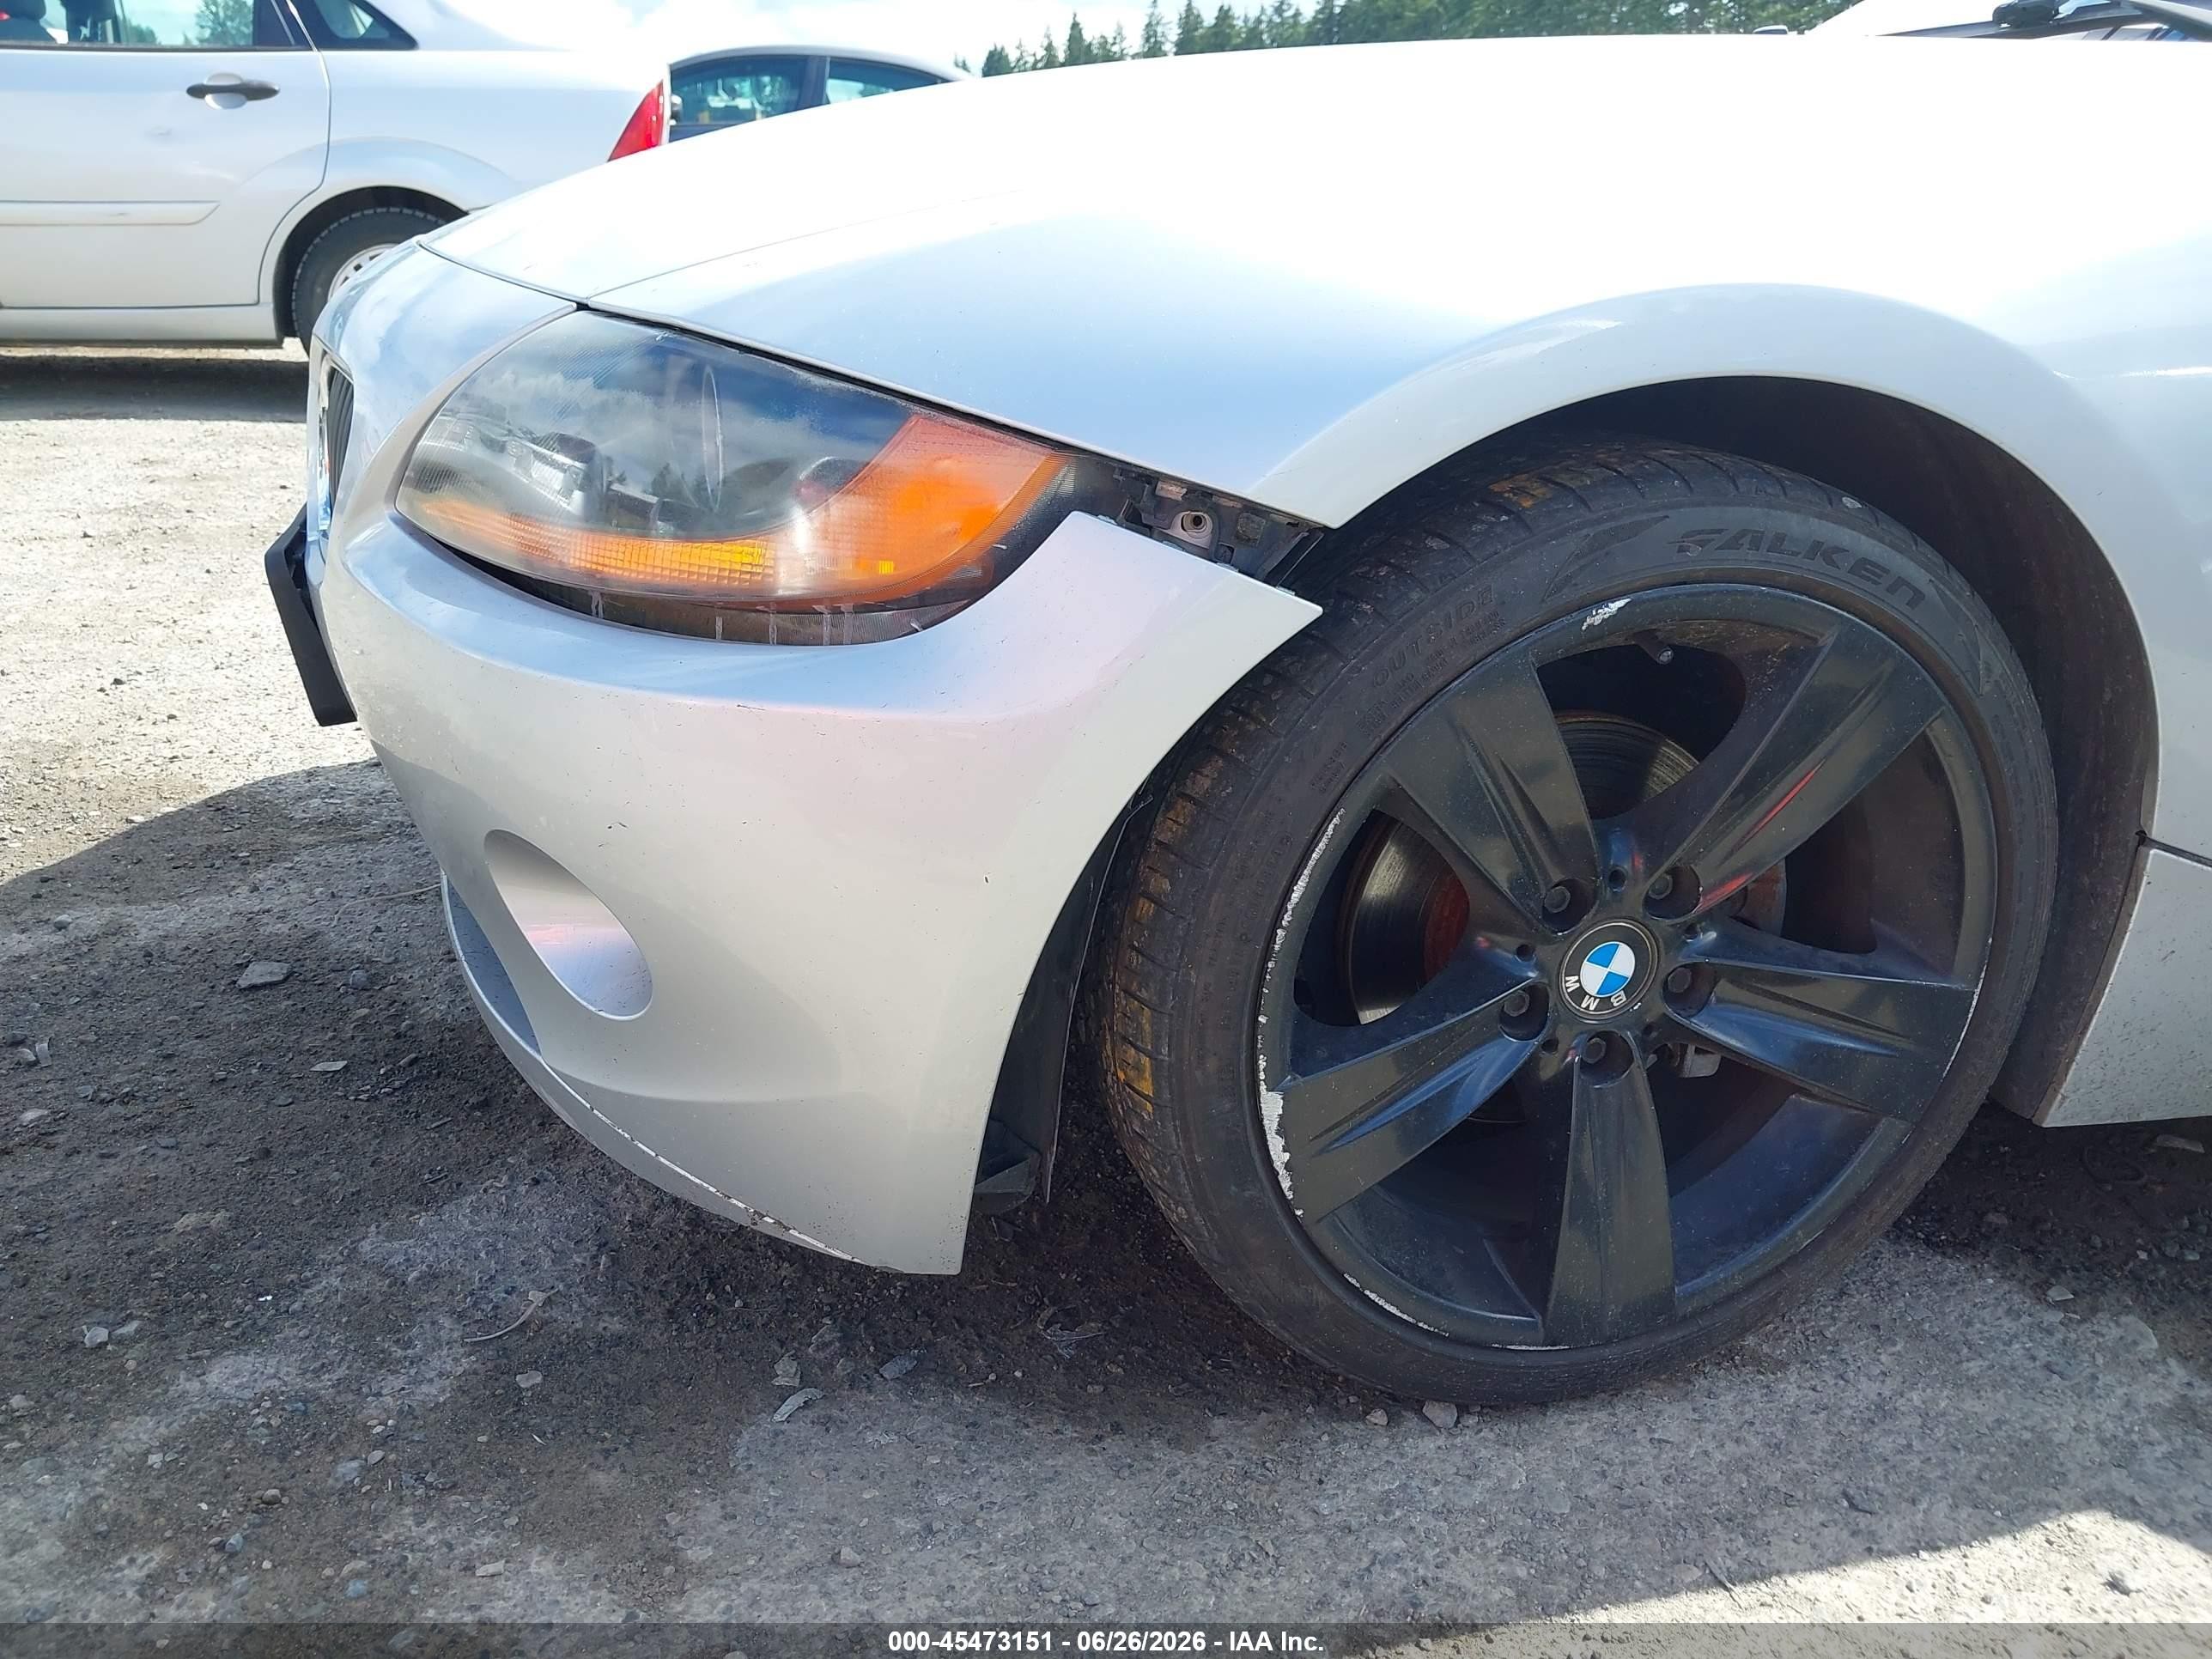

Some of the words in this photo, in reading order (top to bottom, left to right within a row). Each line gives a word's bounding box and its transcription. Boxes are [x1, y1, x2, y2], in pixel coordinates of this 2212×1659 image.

[1668, 528, 1926, 611] FALKEN
[1375, 584, 1494, 688] OUTSIDE
[1565, 975, 1627, 1011] BMW
